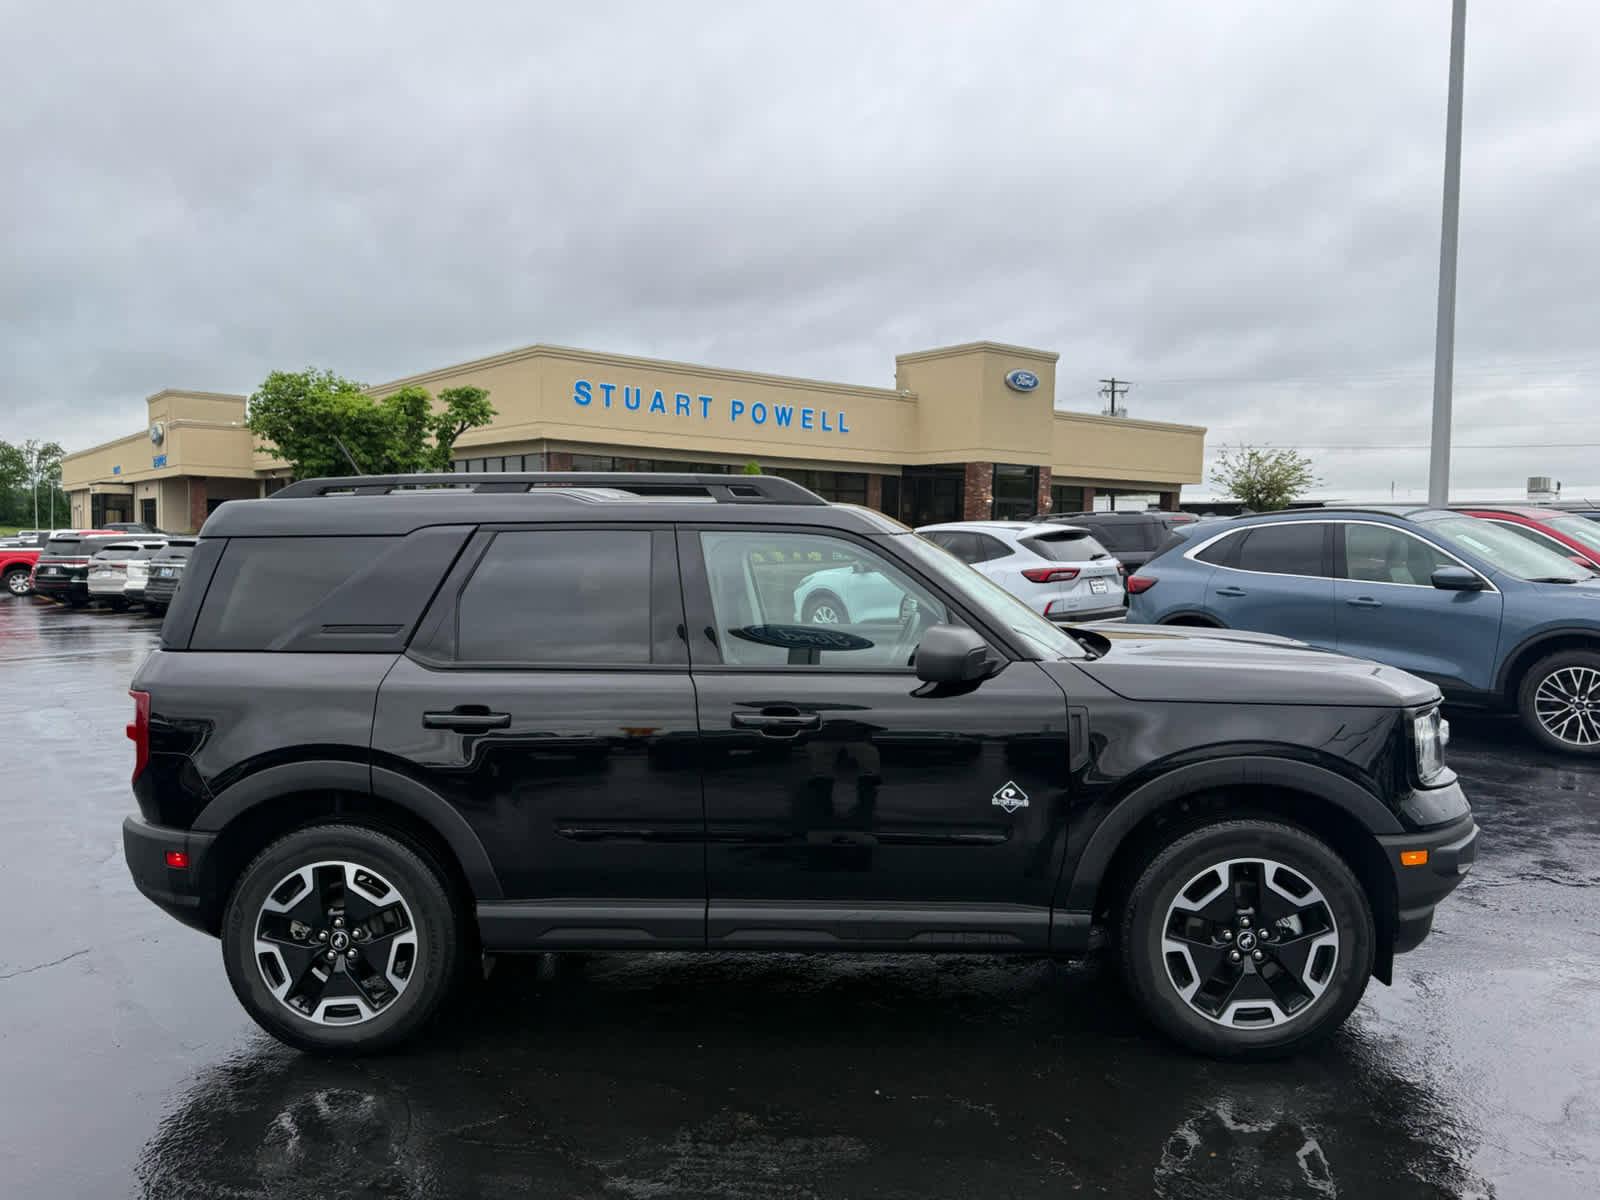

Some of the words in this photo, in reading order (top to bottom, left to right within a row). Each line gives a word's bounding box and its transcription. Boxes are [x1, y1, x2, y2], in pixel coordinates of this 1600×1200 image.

[1014, 373, 1037, 387] Ford
[573, 380, 713, 418] STUART
[730, 400, 850, 433] POWELL
